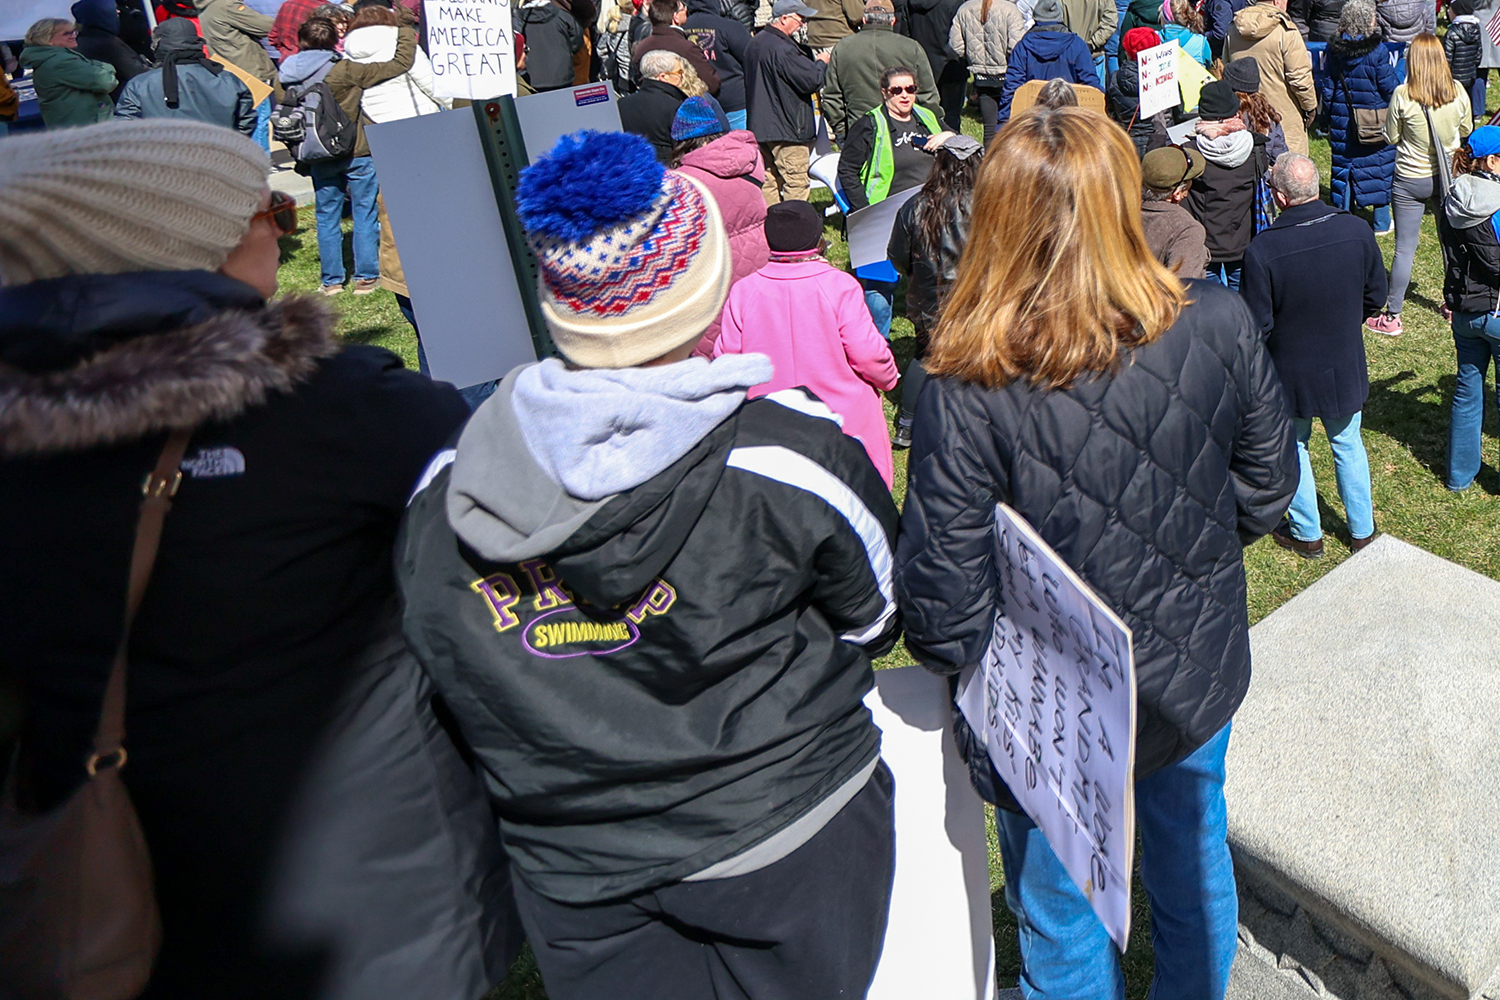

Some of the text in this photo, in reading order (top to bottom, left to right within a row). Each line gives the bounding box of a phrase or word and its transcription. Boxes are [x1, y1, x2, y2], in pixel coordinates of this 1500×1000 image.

[439, 6, 486, 23] MAKE
[429, 26, 509, 47] AMERICA
[430, 52, 507, 76] GREAT
[1159, 60, 1171, 72] ICE
[470, 559, 678, 632] PRP
[533, 620, 632, 648] SWIMMING
[1098, 715, 1117, 763] A
